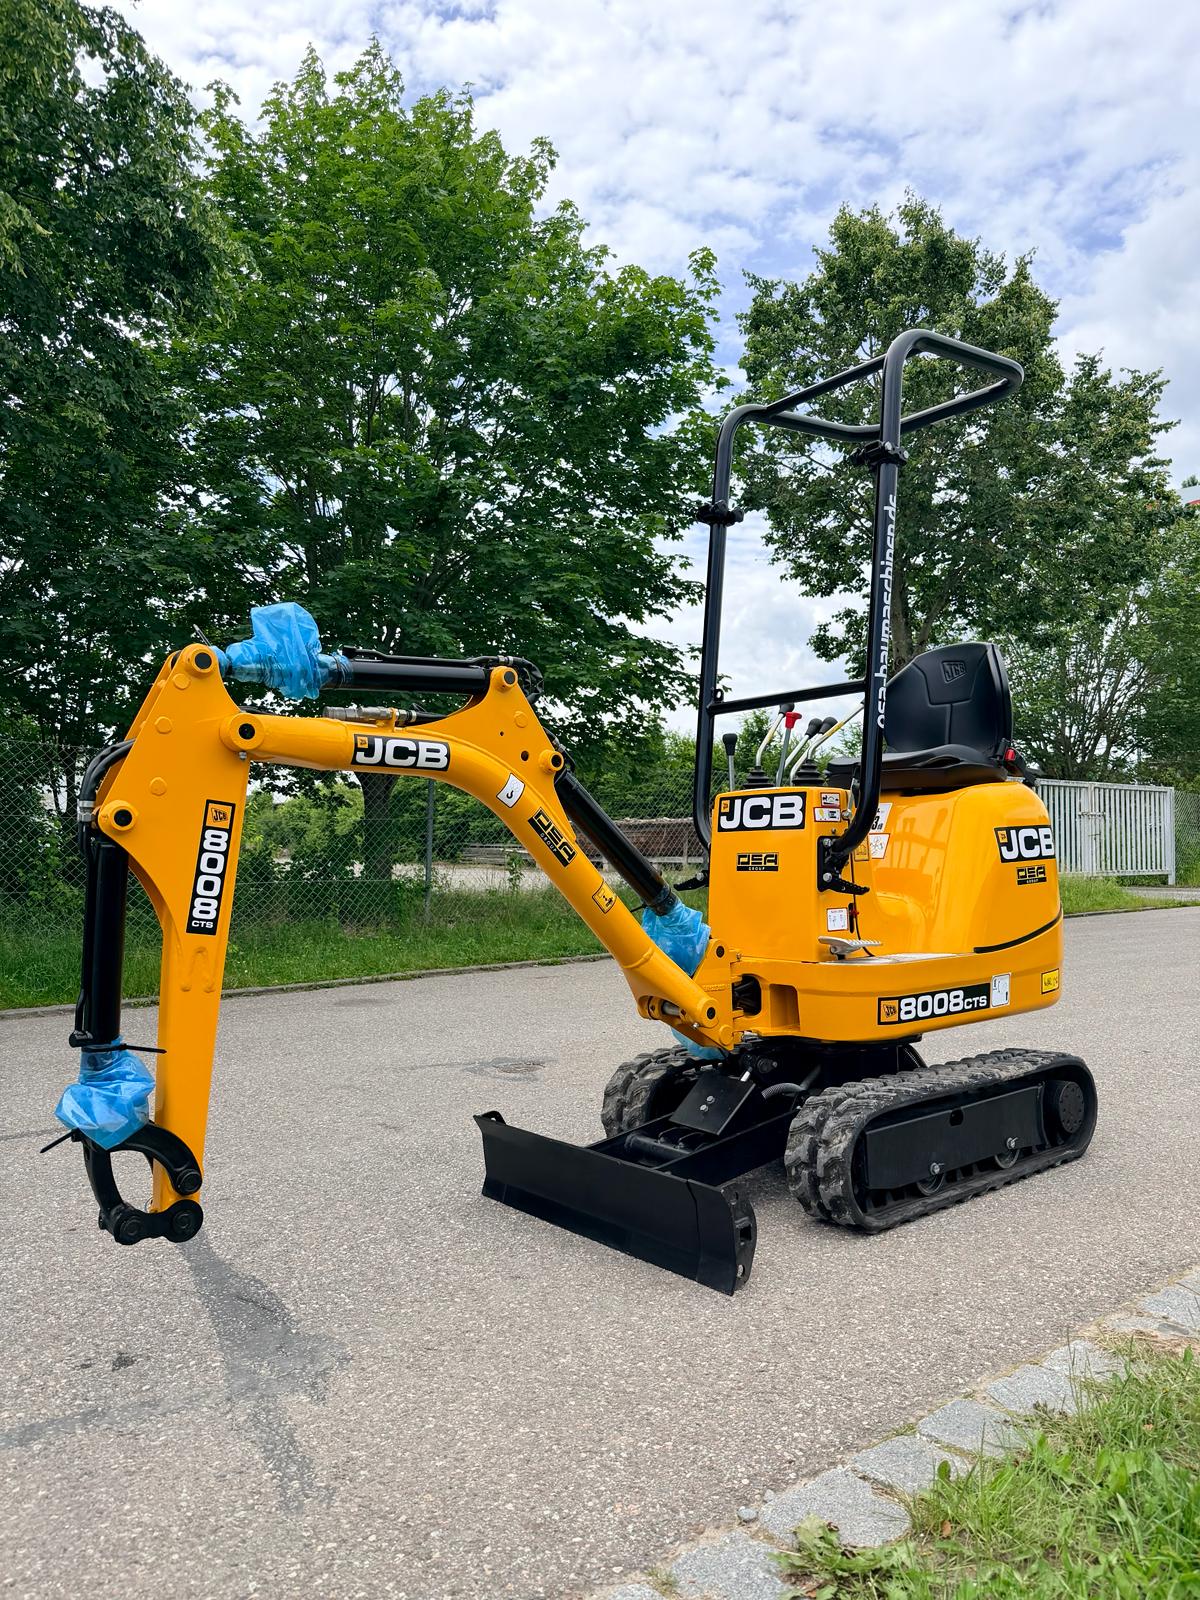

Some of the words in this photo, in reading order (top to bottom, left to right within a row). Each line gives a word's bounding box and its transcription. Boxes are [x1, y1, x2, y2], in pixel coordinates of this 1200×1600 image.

[944, 661, 967, 681] JCB
[355, 737, 448, 769] JCB
[213, 808, 228, 823] JCB
[719, 795, 804, 829] JCB
[540, 832, 557, 852] GROUP
[1000, 827, 1055, 860] JCB
[192, 829, 229, 920] 8008
[191, 920, 214, 929] CTS
